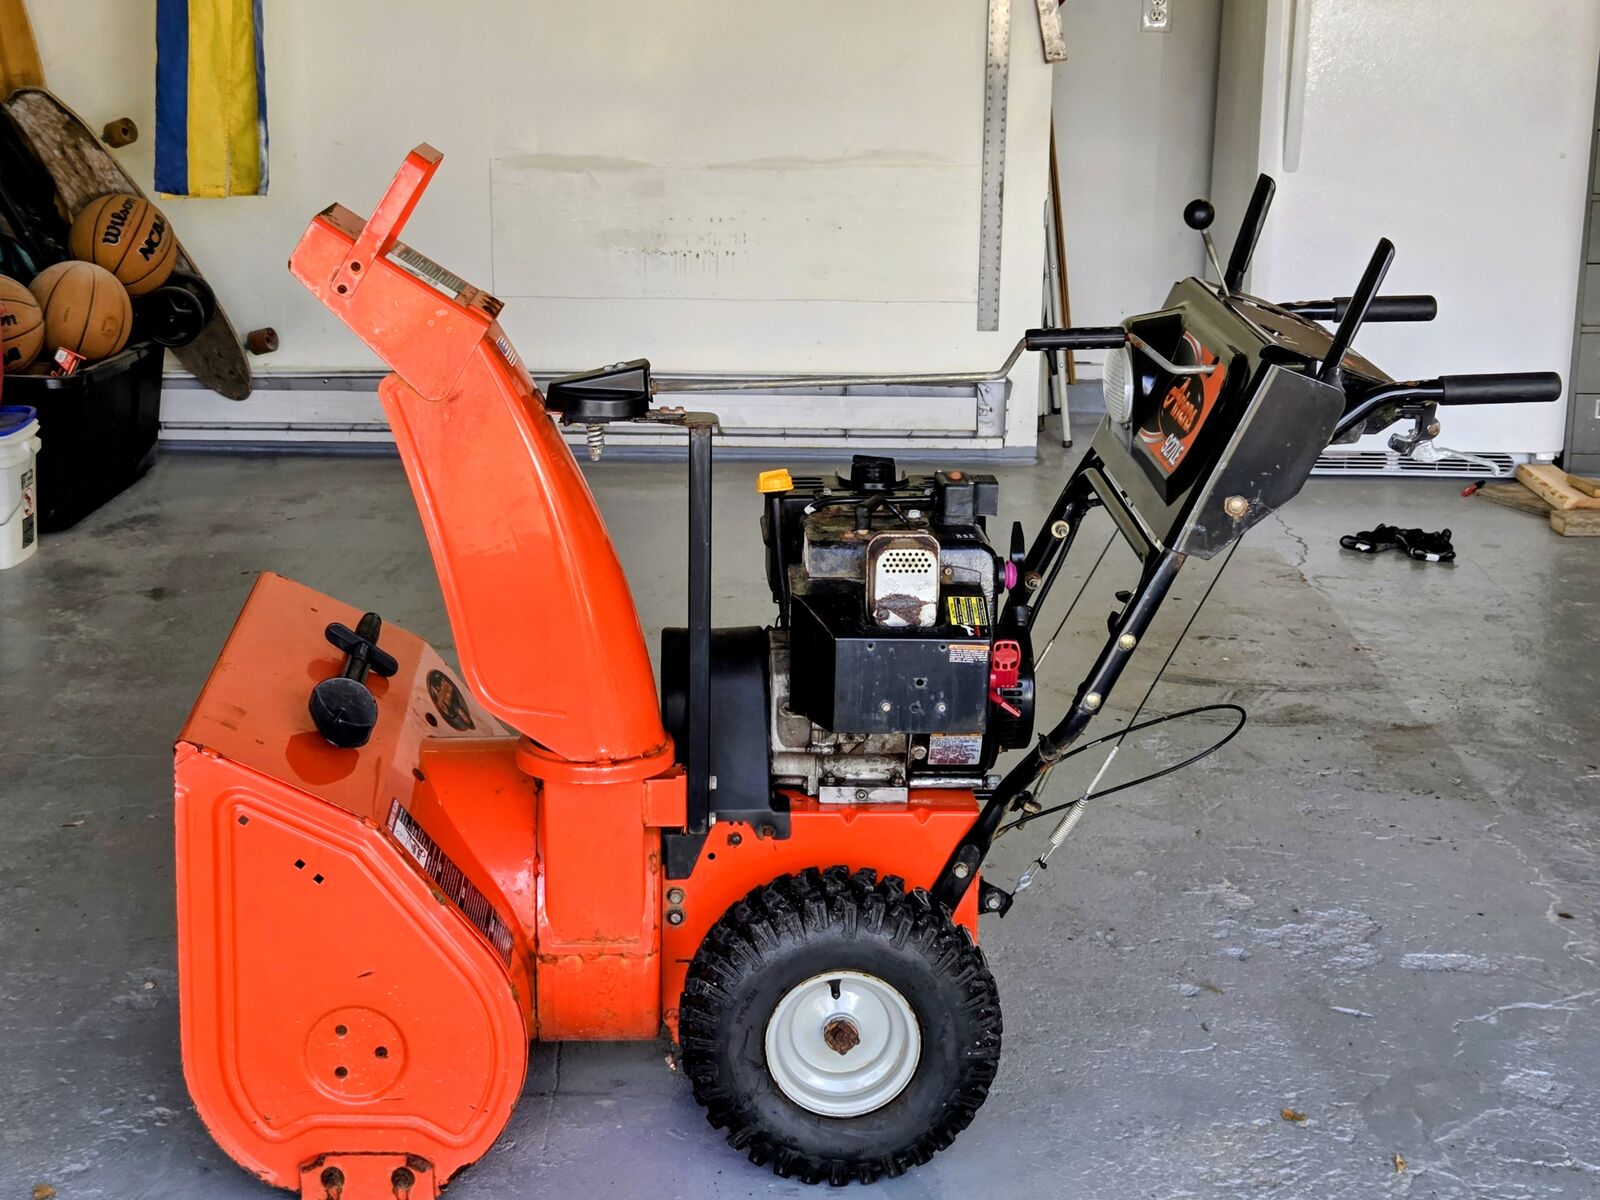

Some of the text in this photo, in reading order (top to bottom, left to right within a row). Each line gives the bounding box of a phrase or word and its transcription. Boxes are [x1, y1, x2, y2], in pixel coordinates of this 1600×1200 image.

[102, 197, 136, 245] Wilson
[1163, 377, 1198, 433] Ariens
[1160, 432, 1184, 466] 927LE
